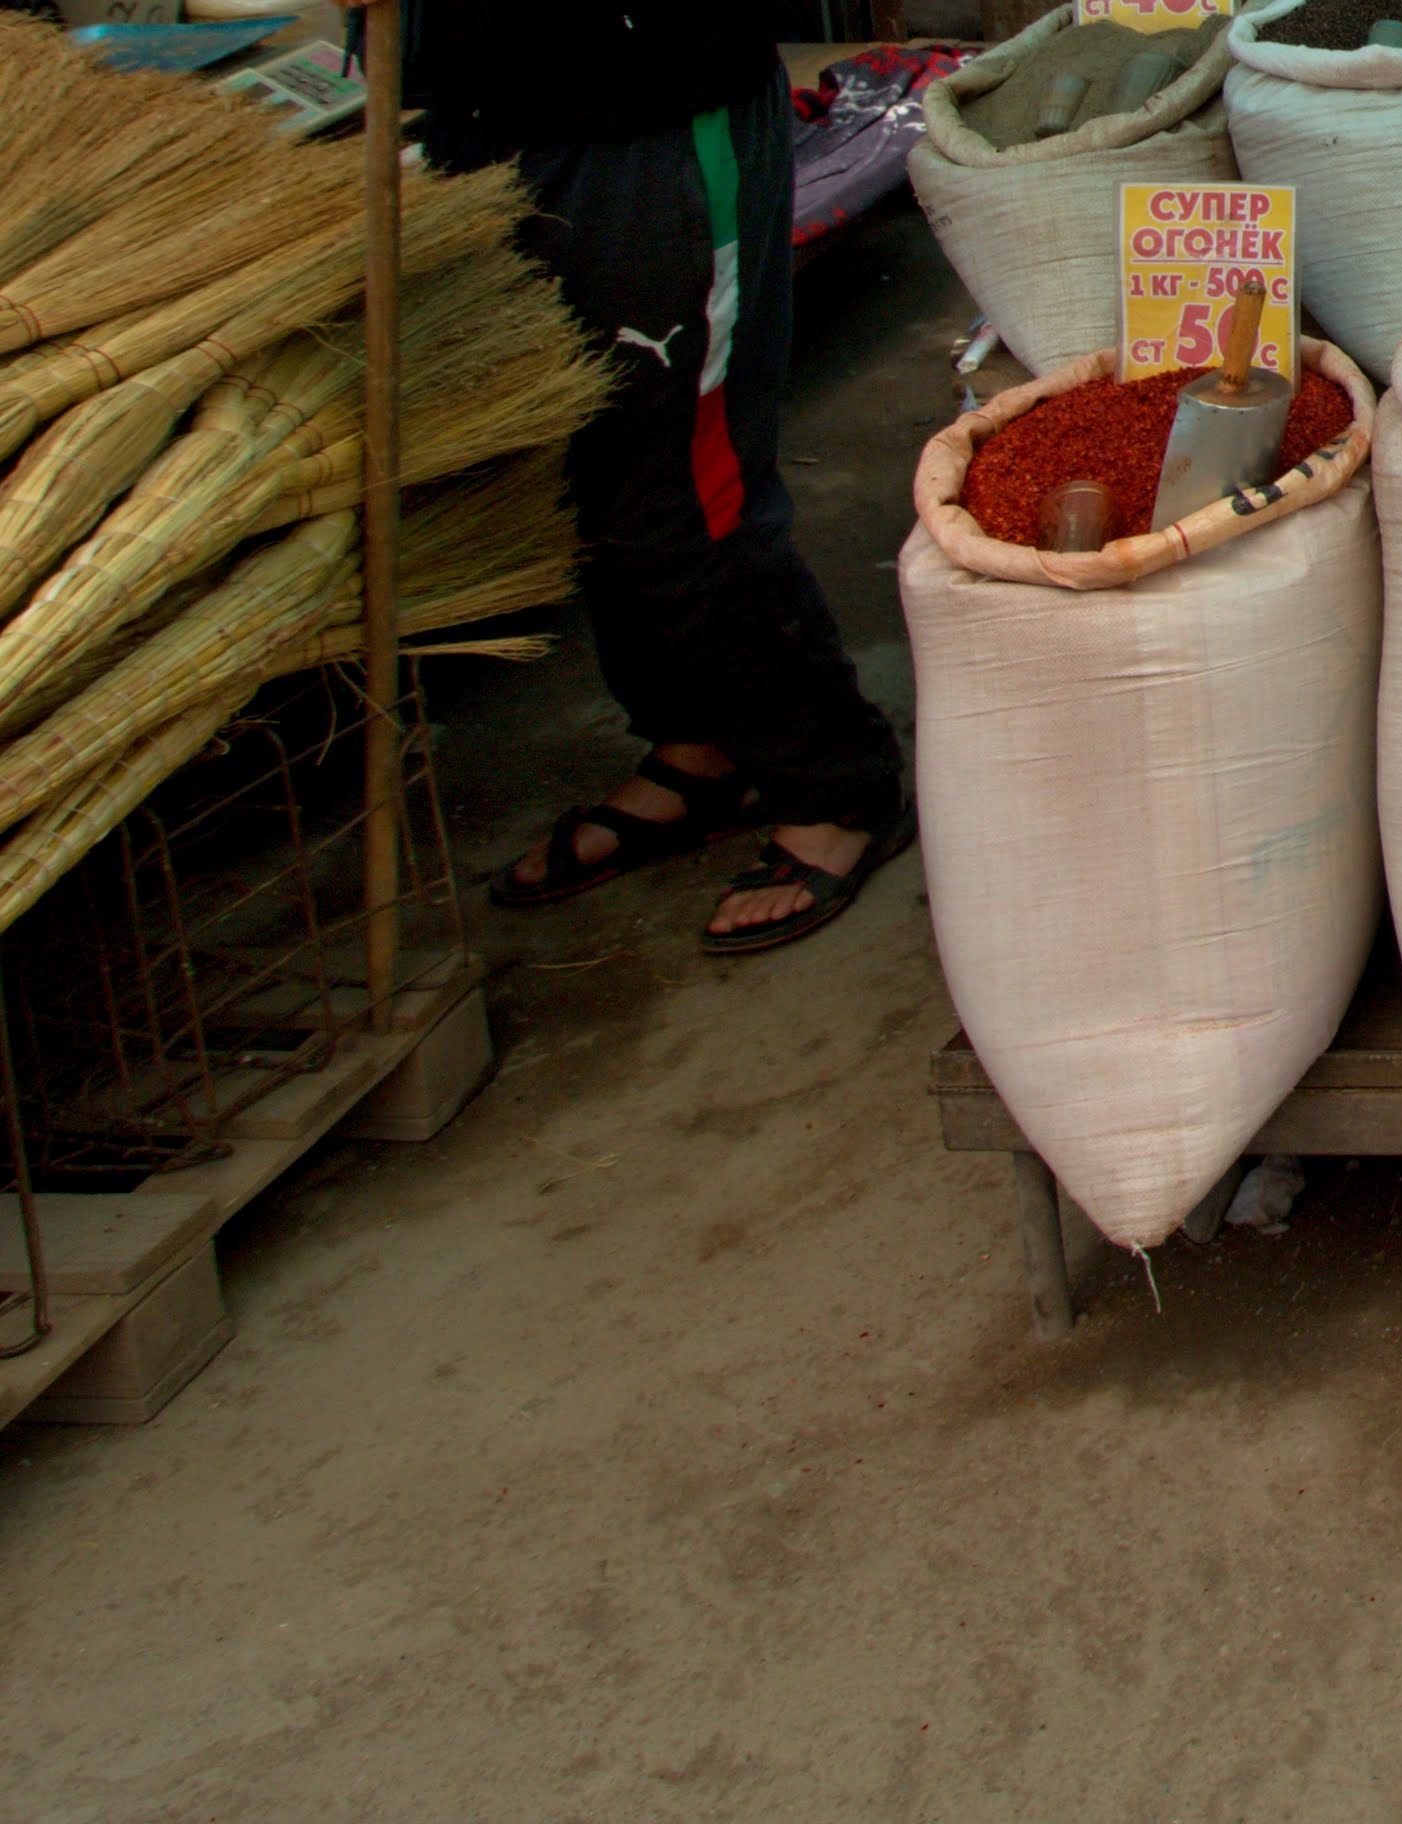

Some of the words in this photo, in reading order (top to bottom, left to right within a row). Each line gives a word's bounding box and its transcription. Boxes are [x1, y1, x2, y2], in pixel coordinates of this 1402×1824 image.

[1151, 192, 1269, 221] СУПЕР
[1133, 221, 1283, 260] ОГОНЁК
[1131, 275, 1143, 296] 1
